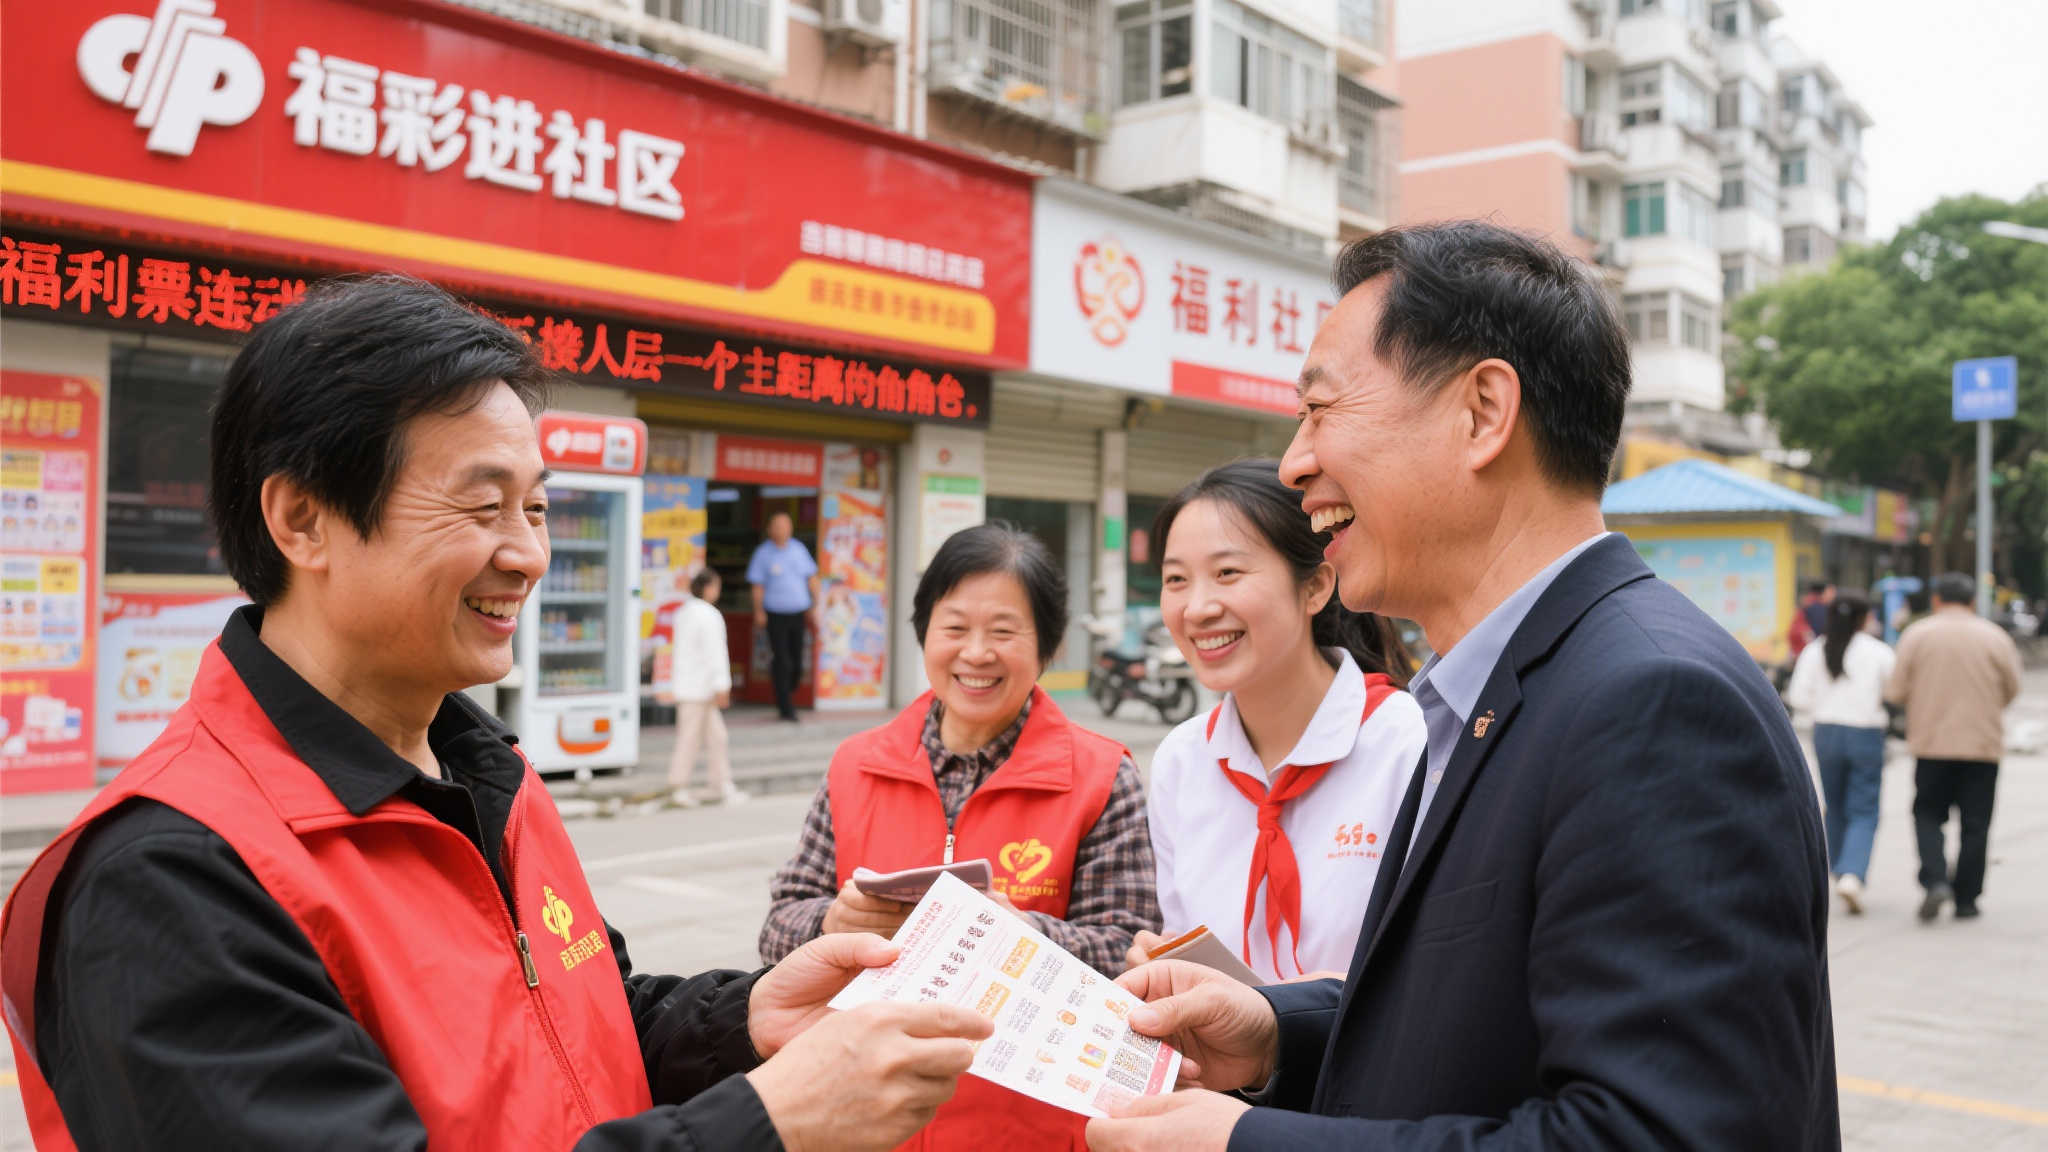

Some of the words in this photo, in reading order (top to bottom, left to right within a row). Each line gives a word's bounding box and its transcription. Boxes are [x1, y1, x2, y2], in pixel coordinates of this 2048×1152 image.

[284, 46, 685, 221] 福彩进社区
